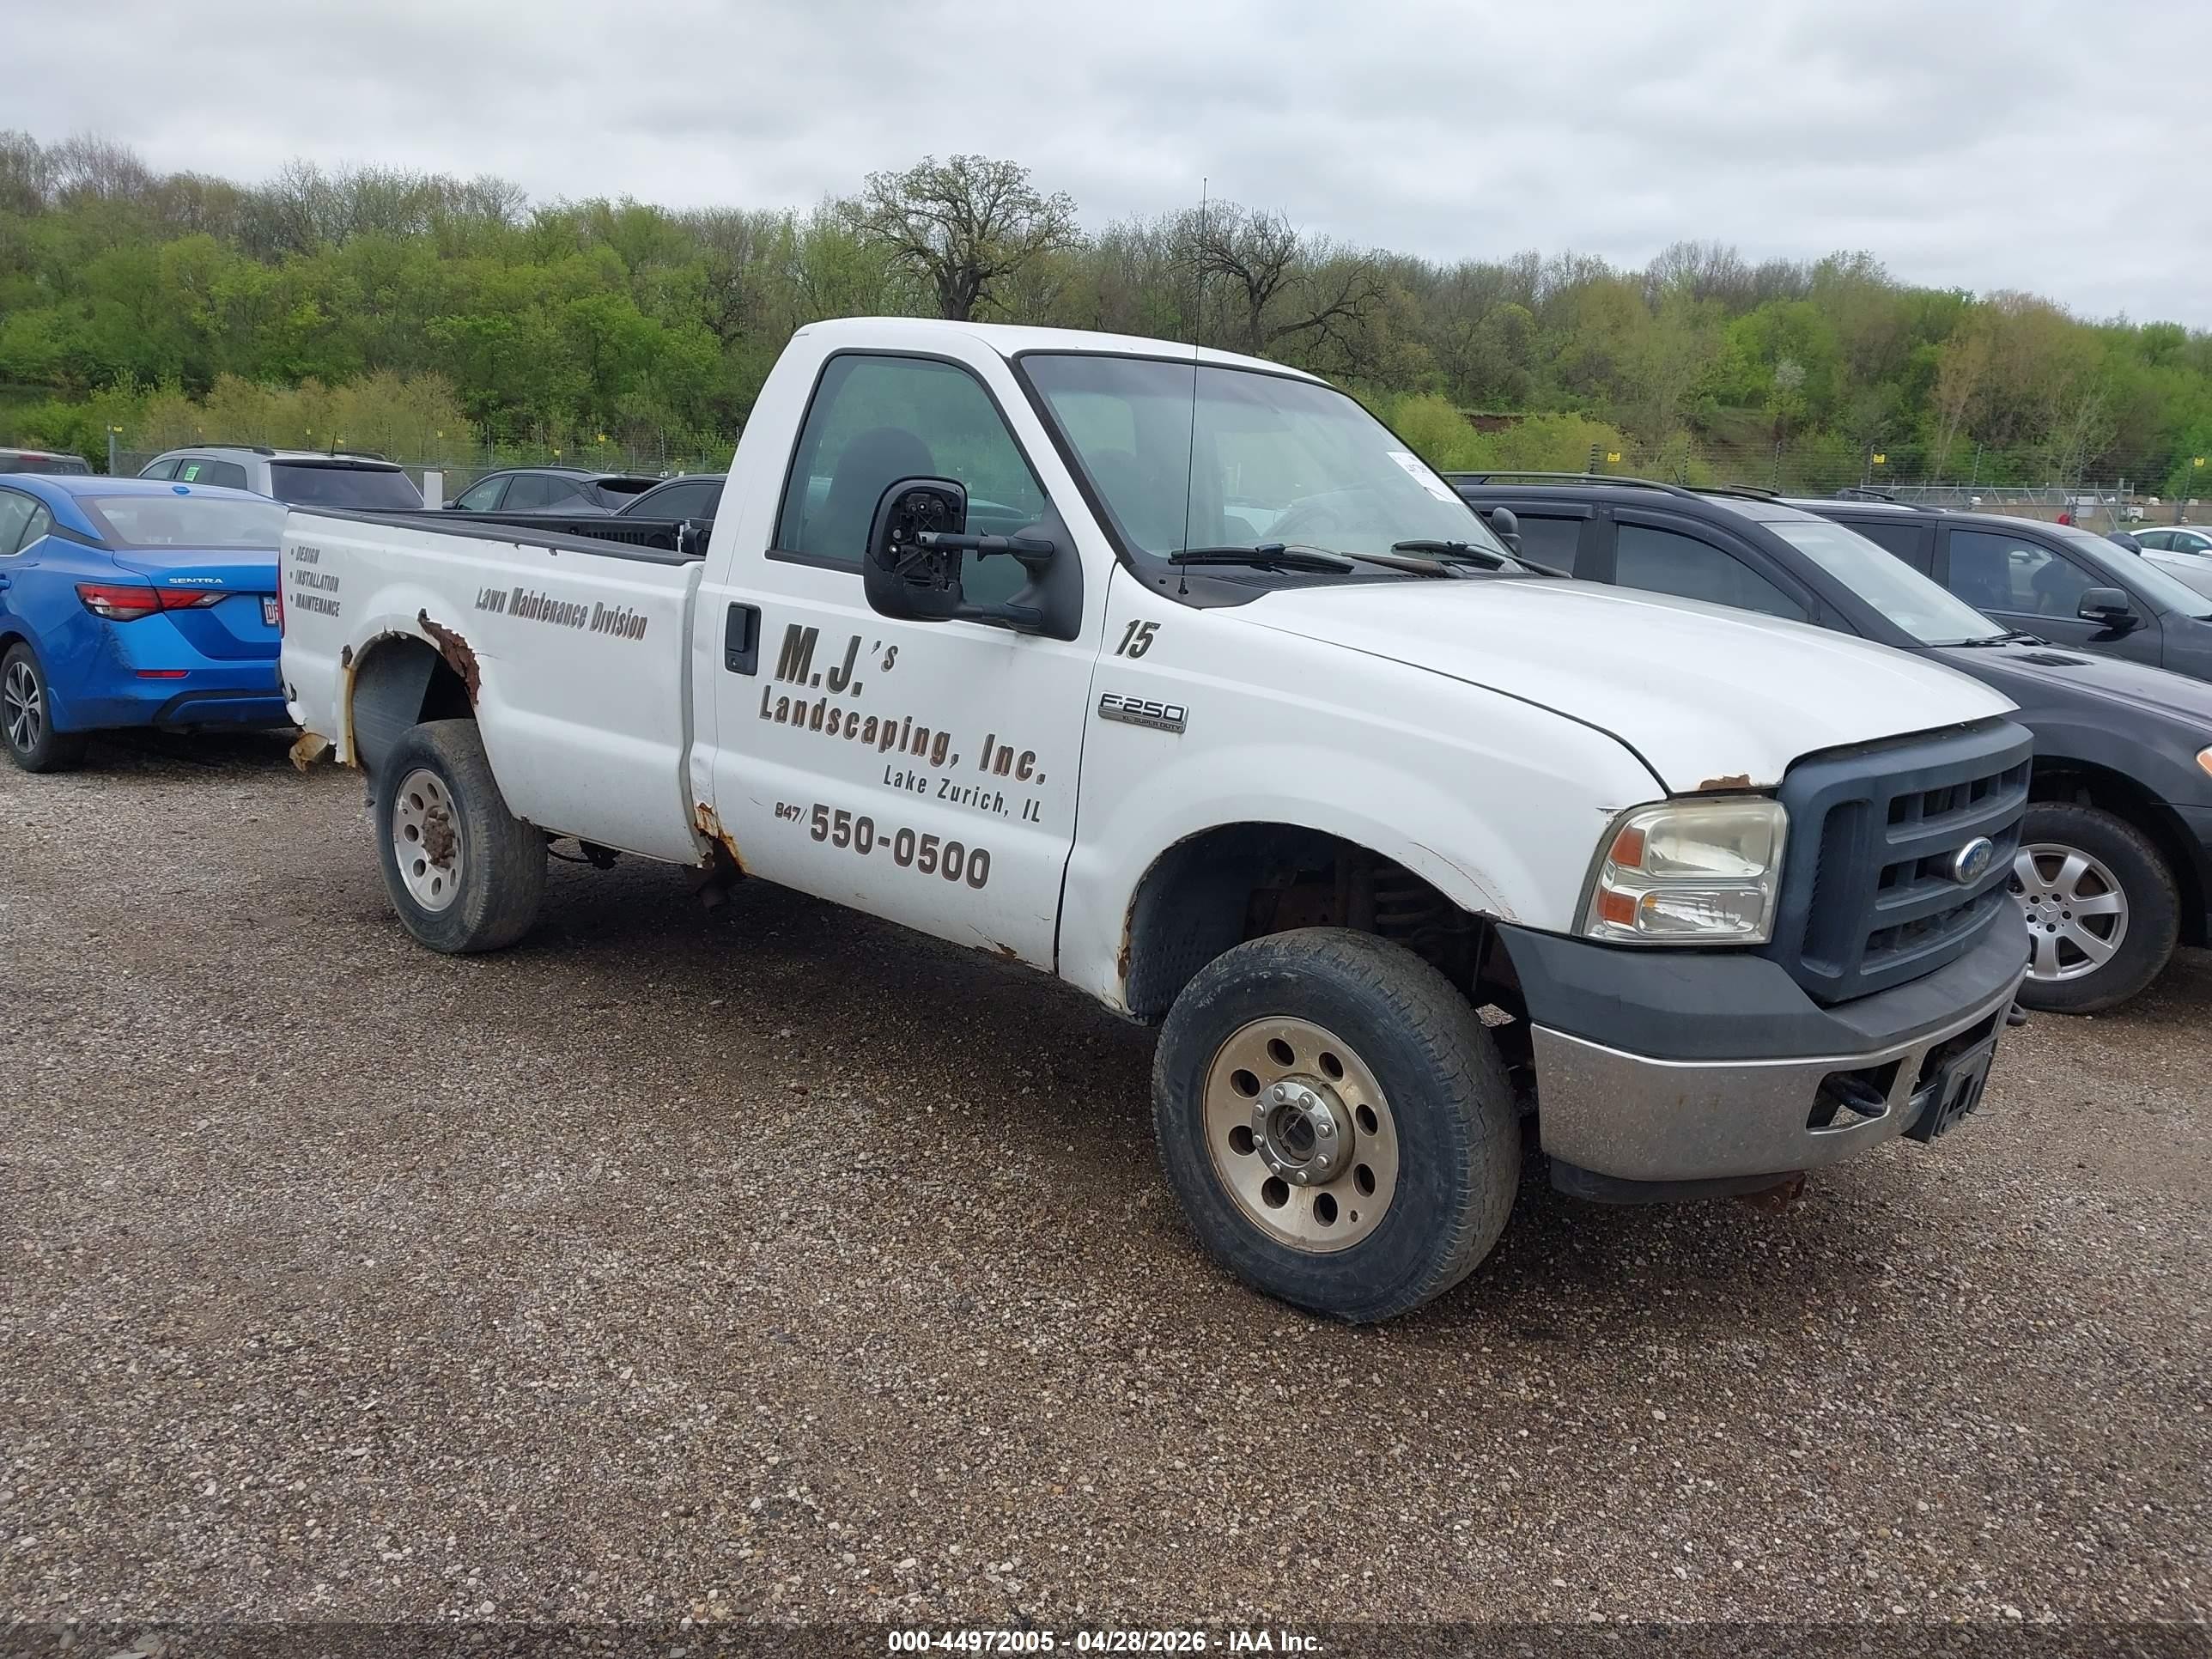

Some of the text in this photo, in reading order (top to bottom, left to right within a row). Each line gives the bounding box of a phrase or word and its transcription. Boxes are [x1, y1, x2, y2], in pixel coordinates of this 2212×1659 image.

[295, 545, 320, 564] DESIGN
[294, 569, 340, 593] INSTALLATION
[295, 592, 341, 617] MAINTENANCE
[474, 586, 648, 641] Lawn Maintenance Division
[1114, 618, 1162, 659] 15
[775, 623, 898, 697] M.J.'s
[1099, 692, 1185, 723] F-250
[1133, 717, 1158, 727] SUPER
[1159, 722, 1183, 731] DUTY
[759, 684, 1046, 785] Landscaping, Inc.
[883, 764, 1042, 823] Lake Zurich, IL
[810, 803, 991, 890] 550-0500
